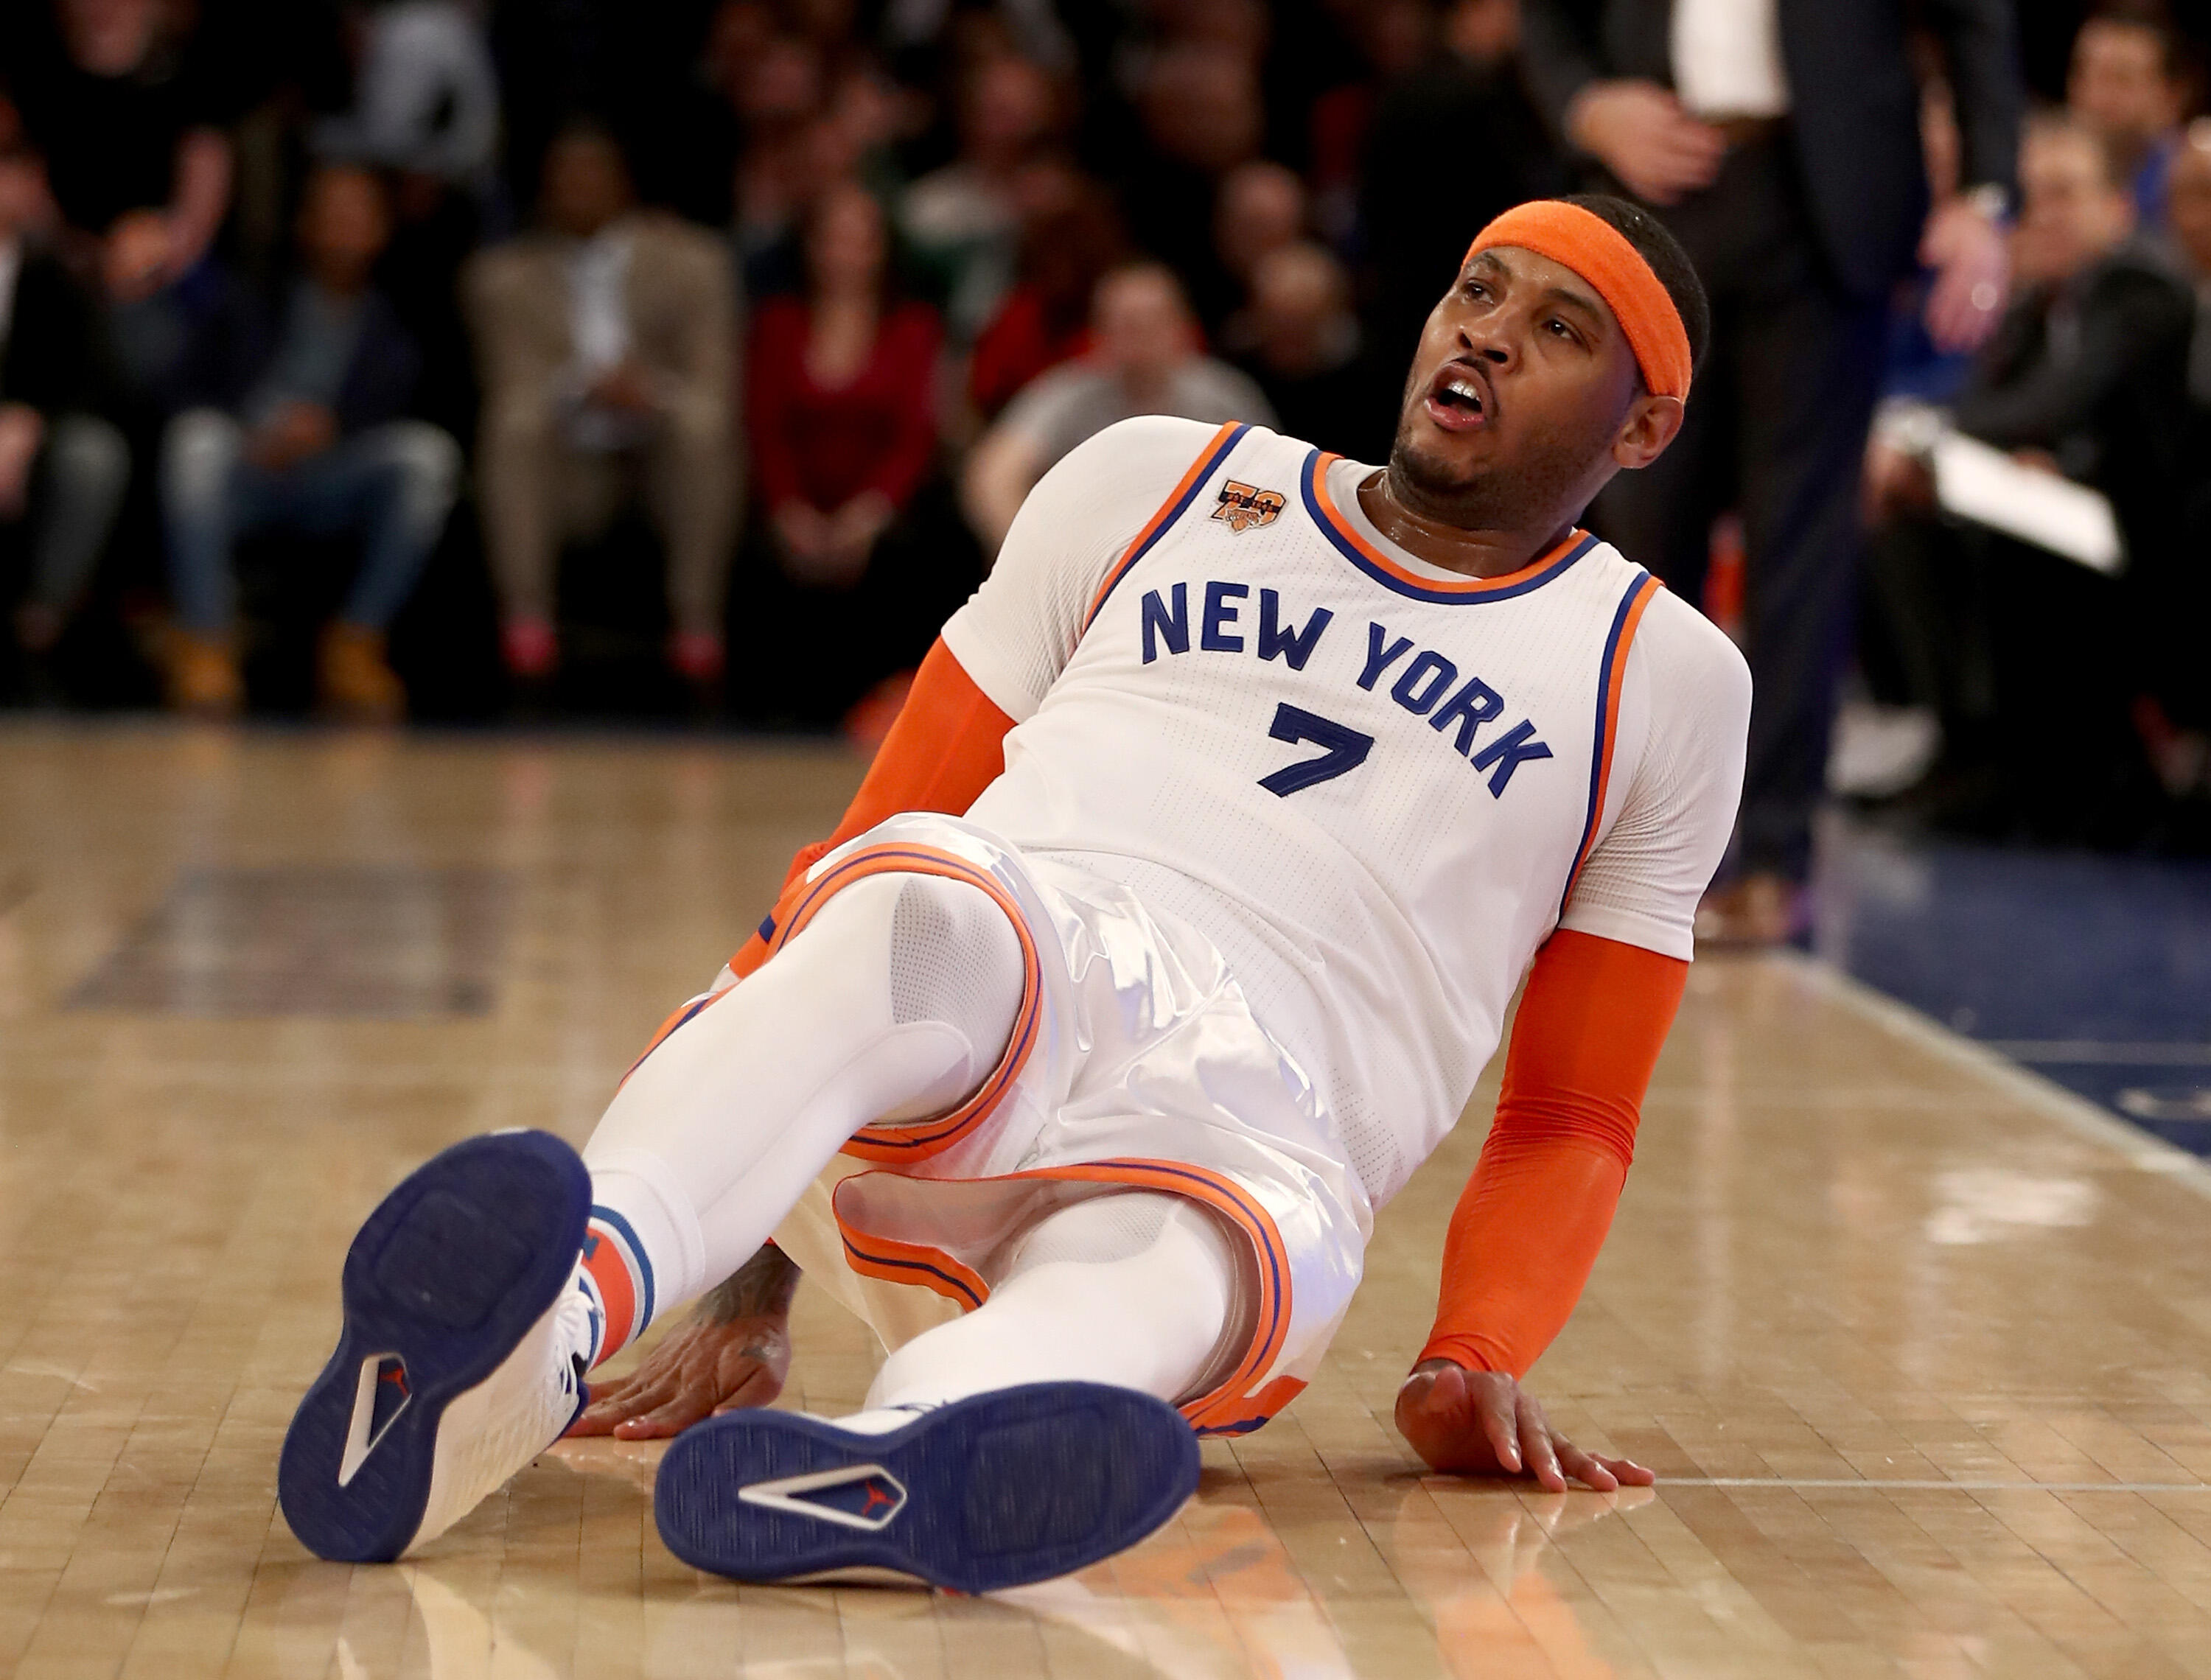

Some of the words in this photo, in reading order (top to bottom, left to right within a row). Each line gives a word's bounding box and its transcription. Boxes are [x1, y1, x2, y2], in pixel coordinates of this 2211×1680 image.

[1142, 581, 1334, 671] NEW
[1357, 622, 1554, 799] YORK
[1257, 701, 1375, 798] 7
